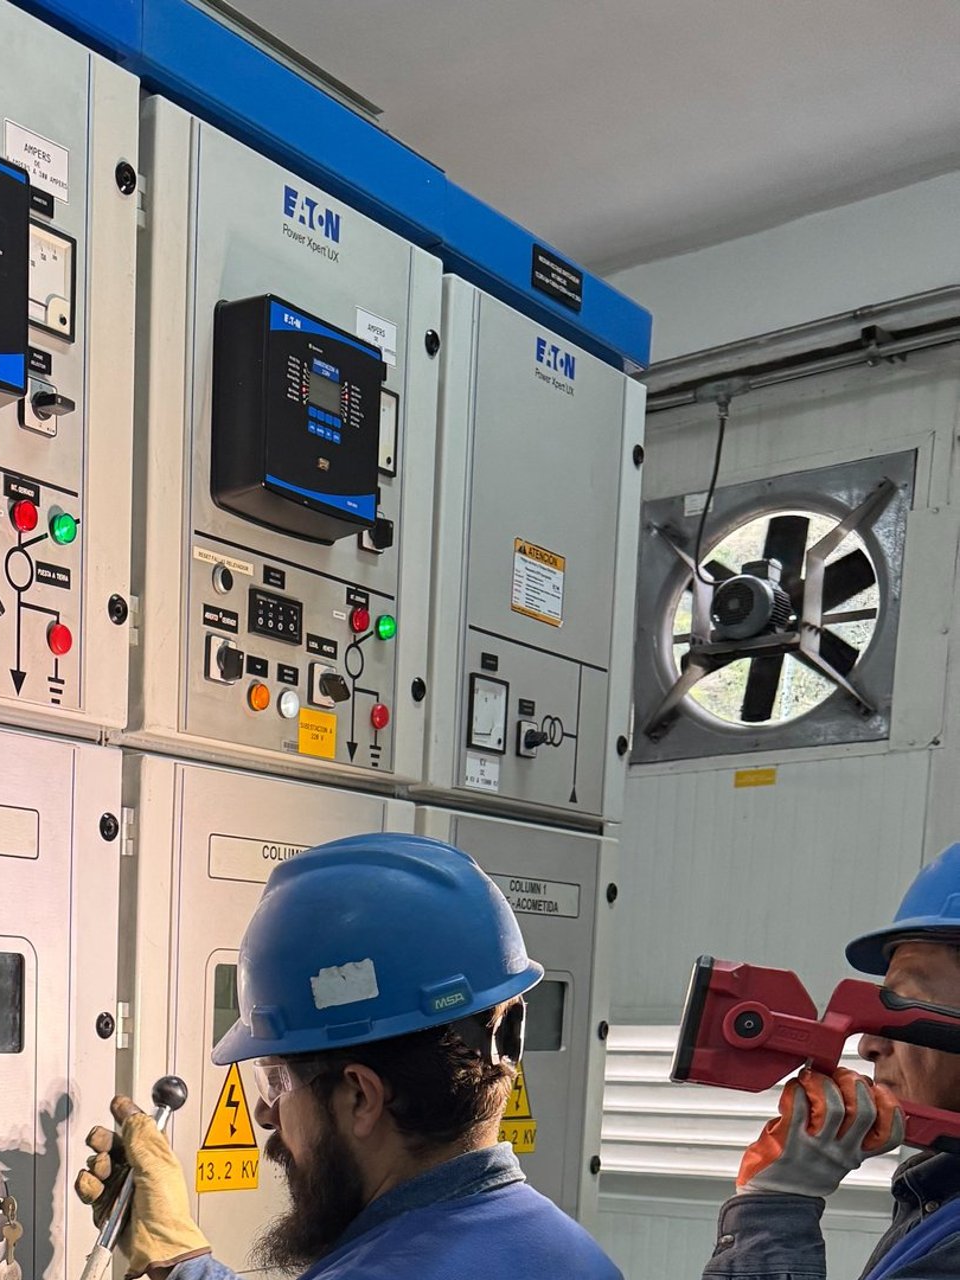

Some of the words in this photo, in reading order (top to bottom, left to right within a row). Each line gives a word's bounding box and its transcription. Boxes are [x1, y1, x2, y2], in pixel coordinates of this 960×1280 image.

[24, 143, 52, 164] AMPERS
[283, 184, 341, 244] EATON
[282, 223, 306, 245] Power
[306, 236, 327, 257] Xpert
[327, 248, 340, 263] UX
[535, 336, 575, 380] EATON
[262, 845, 303, 861] COLU
[510, 880, 541, 895] COLUMN
[543, 884, 547, 895] 1
[435, 993, 464, 1009] MSA
[524, 1129, 536, 1145] KV
[198, 1161, 232, 1181] 13.2
[241, 1160, 259, 1179] KV
